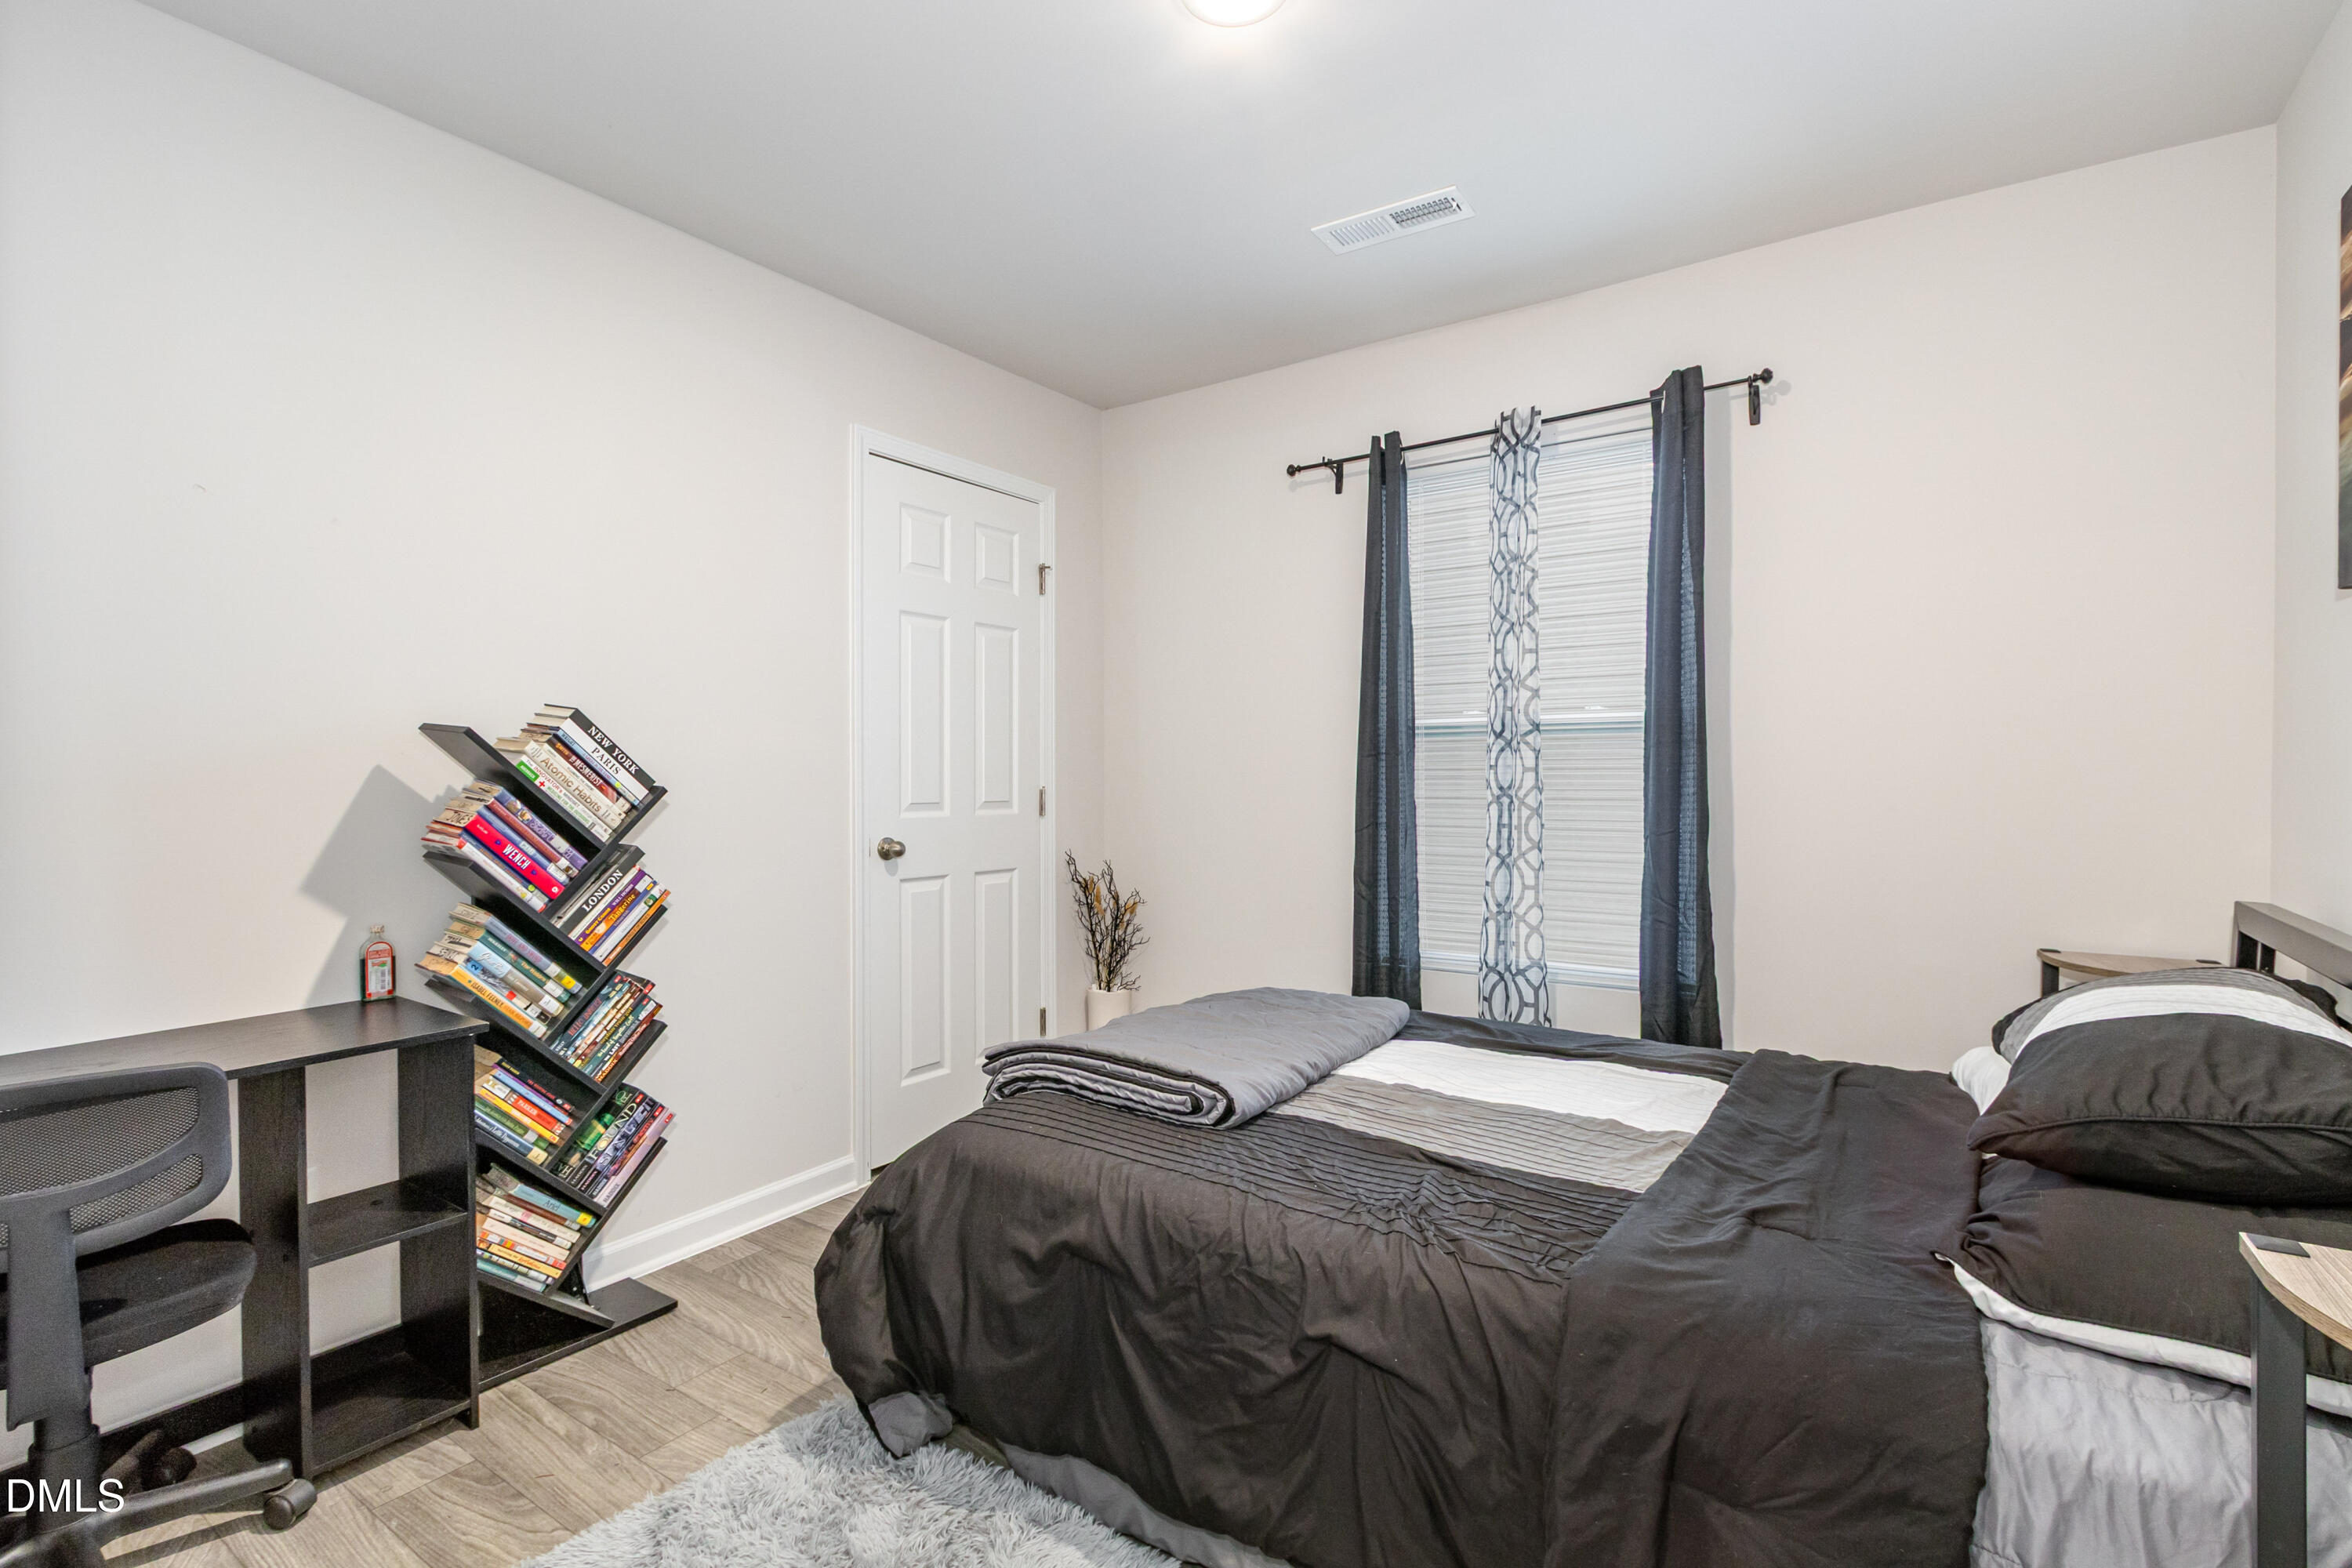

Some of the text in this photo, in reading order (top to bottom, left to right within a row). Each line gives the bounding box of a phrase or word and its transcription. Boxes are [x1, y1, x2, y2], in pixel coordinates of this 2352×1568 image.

[525, 759, 534, 768] The
[587, 725, 612, 750] NEW
[611, 747, 639, 775] YORK
[591, 746, 621, 775] PARIS
[539, 755, 575, 788] Atomic
[572, 784, 604, 813] Habits
[572, 758, 603, 786] MESMERIST
[502, 843, 531, 870] WENCH
[582, 869, 623, 912] LONDON
[611, 895, 622, 906] WILL
[608, 892, 636, 922] Tangerine
[470, 980, 487, 996] ISABEL
[608, 1042, 620, 1054] LAST
[597, 1058, 619, 1082] HADDIX
[588, 1100, 639, 1161] FOUND
[602, 1182, 620, 1203] HADDIX
